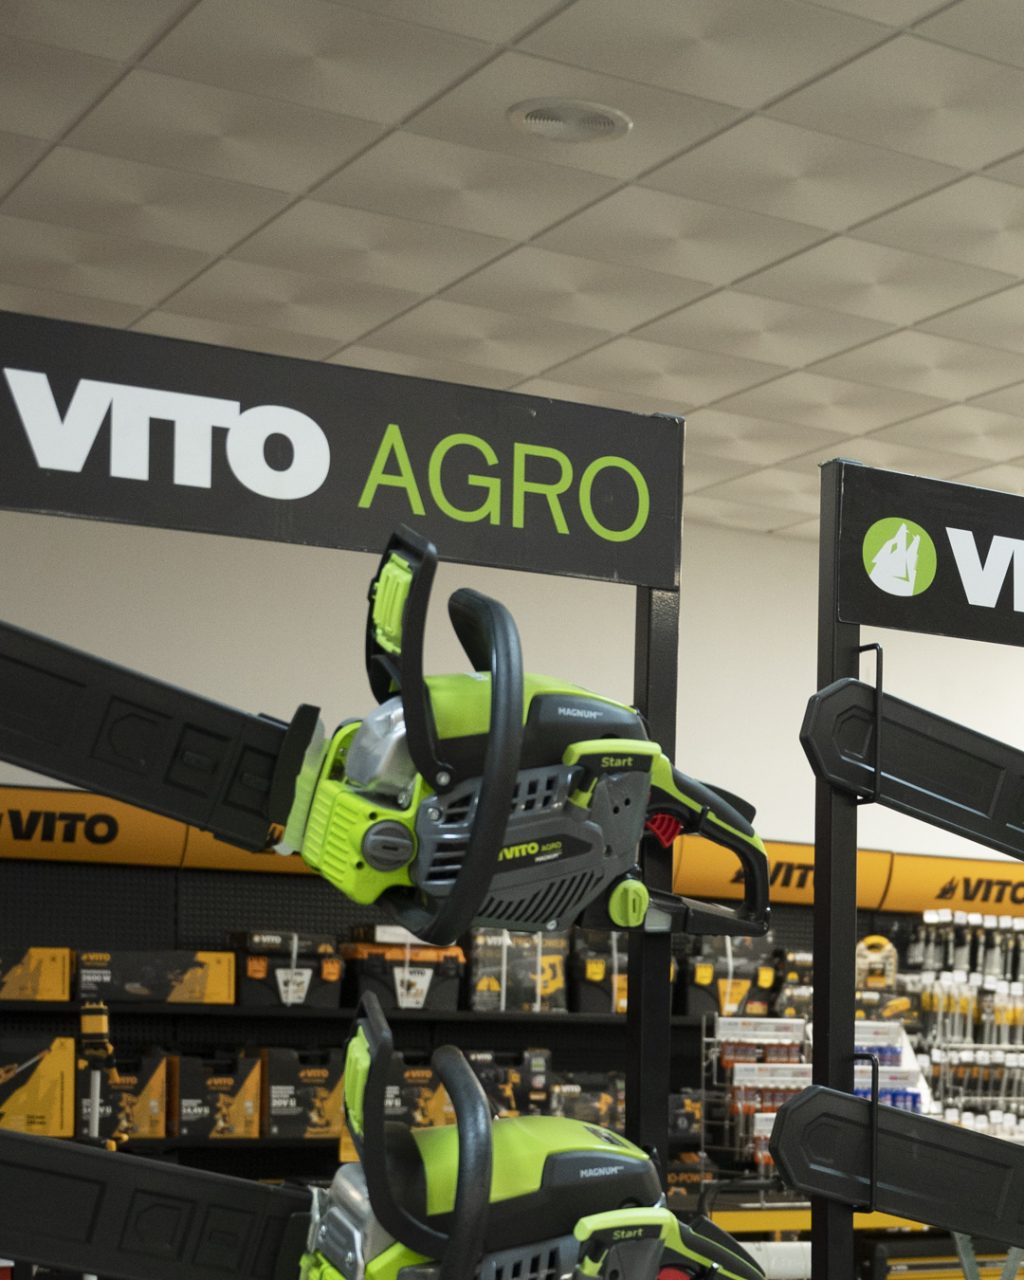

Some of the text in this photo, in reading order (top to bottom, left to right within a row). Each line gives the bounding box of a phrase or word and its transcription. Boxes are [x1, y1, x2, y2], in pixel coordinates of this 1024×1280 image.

[3, 367, 650, 542] VITO AGRO
[601, 756, 634, 768] Start
[8, 809, 119, 845] VITO
[502, 841, 540, 859] VITO
[580, 1167, 618, 1178] MAGNUM
[613, 1228, 644, 1240] Start
